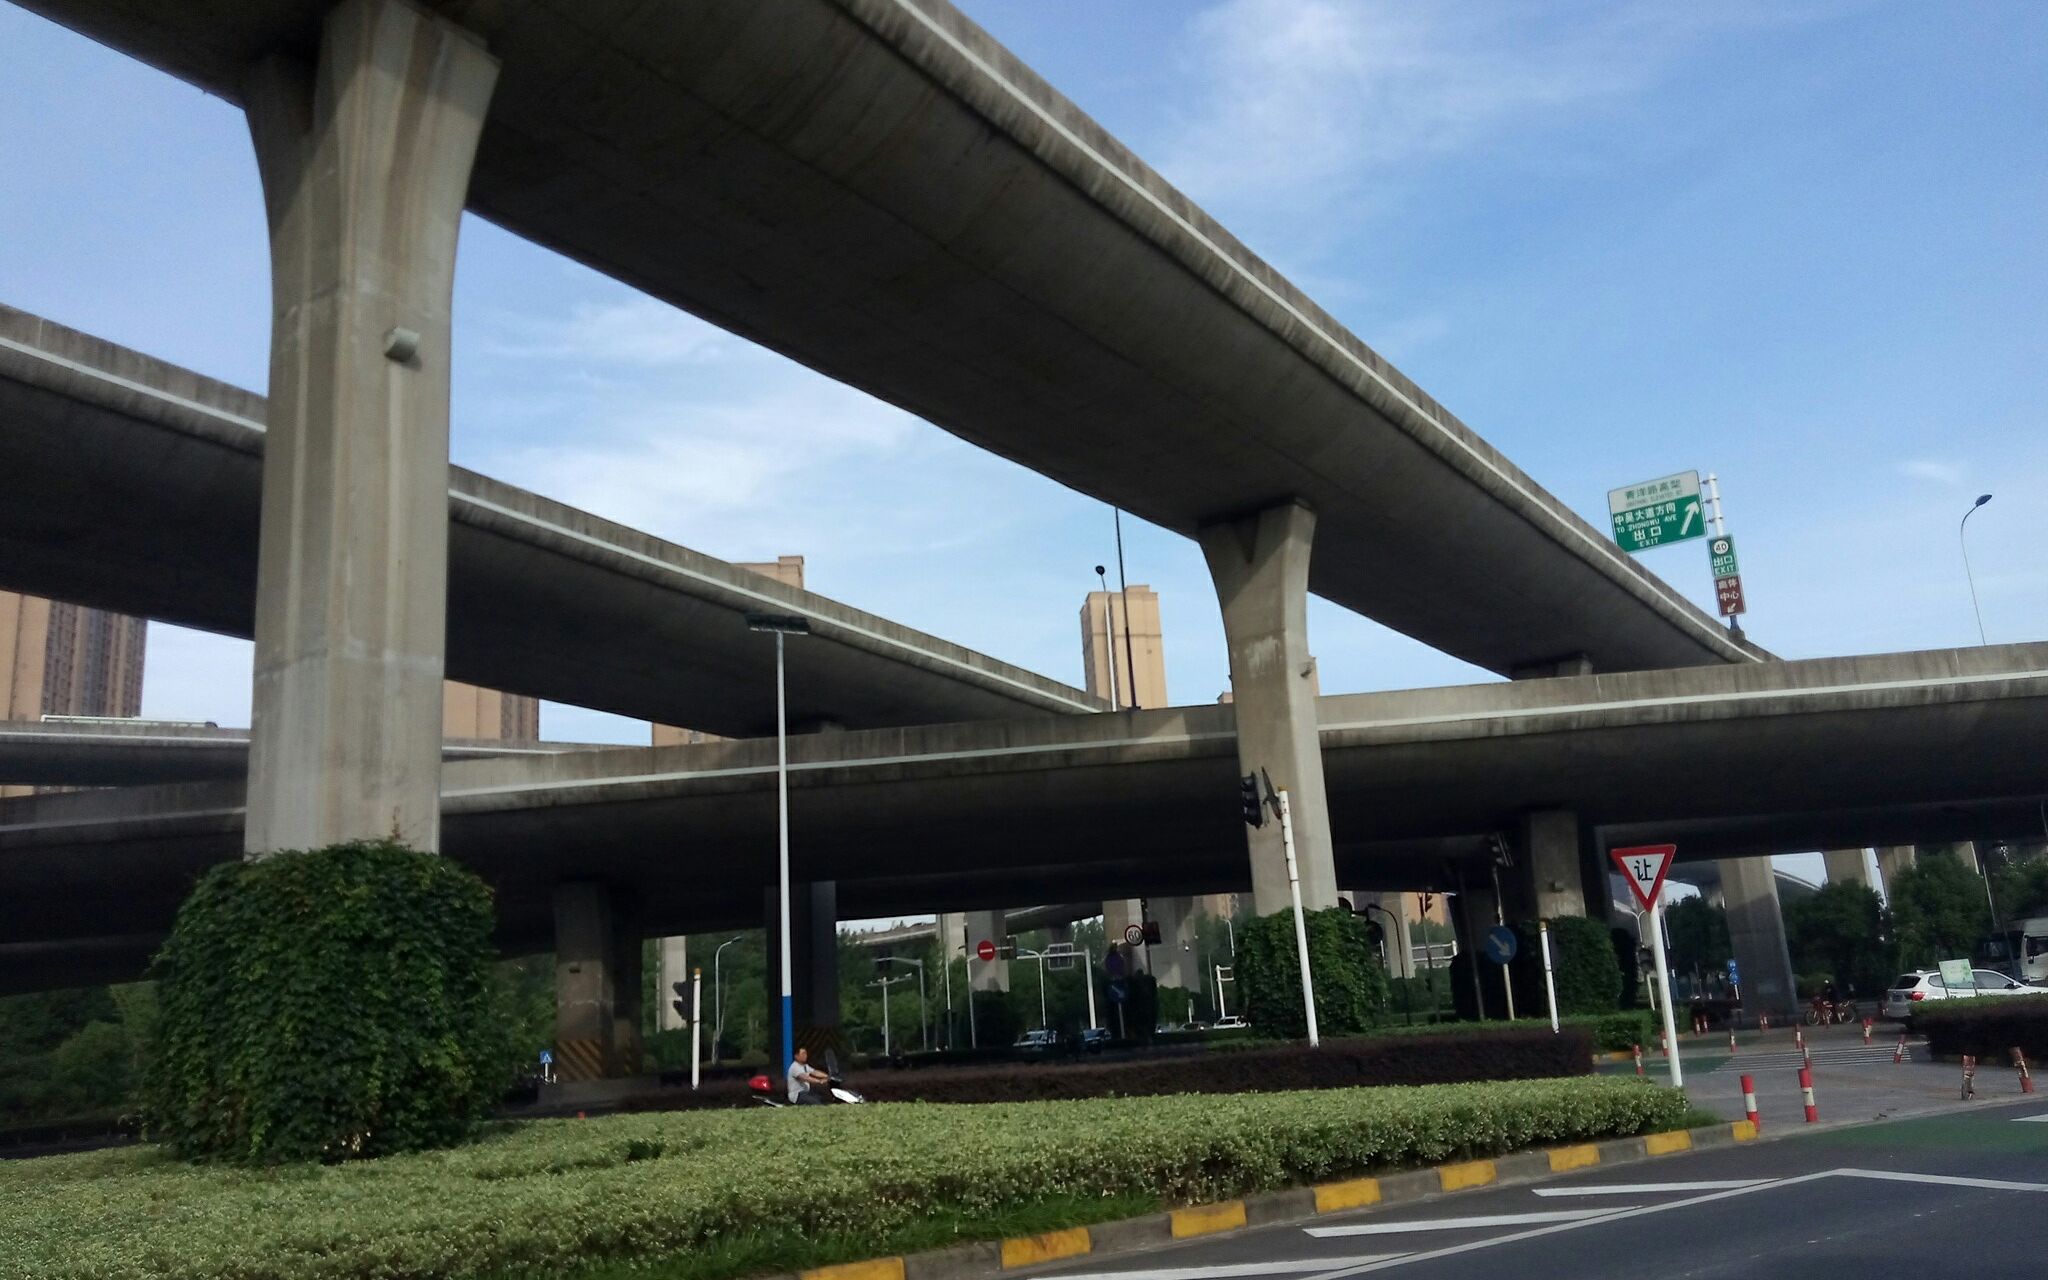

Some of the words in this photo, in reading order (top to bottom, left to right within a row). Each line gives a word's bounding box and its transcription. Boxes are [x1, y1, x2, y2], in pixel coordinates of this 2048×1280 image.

[1614, 502, 1676, 525] 中吴大道方向
[1628, 519, 1660, 532] ZHONGWU
[1664, 514, 1677, 522] AVE
[1634, 526, 1662, 541] 出口
[1639, 538, 1659, 547] EXIT
[1716, 543, 1727, 551] 40
[1714, 555, 1733, 567] 出口
[1715, 565, 1734, 575] EXIT
[1720, 591, 1739, 602] 中心
[1634, 858, 1653, 881] 让
